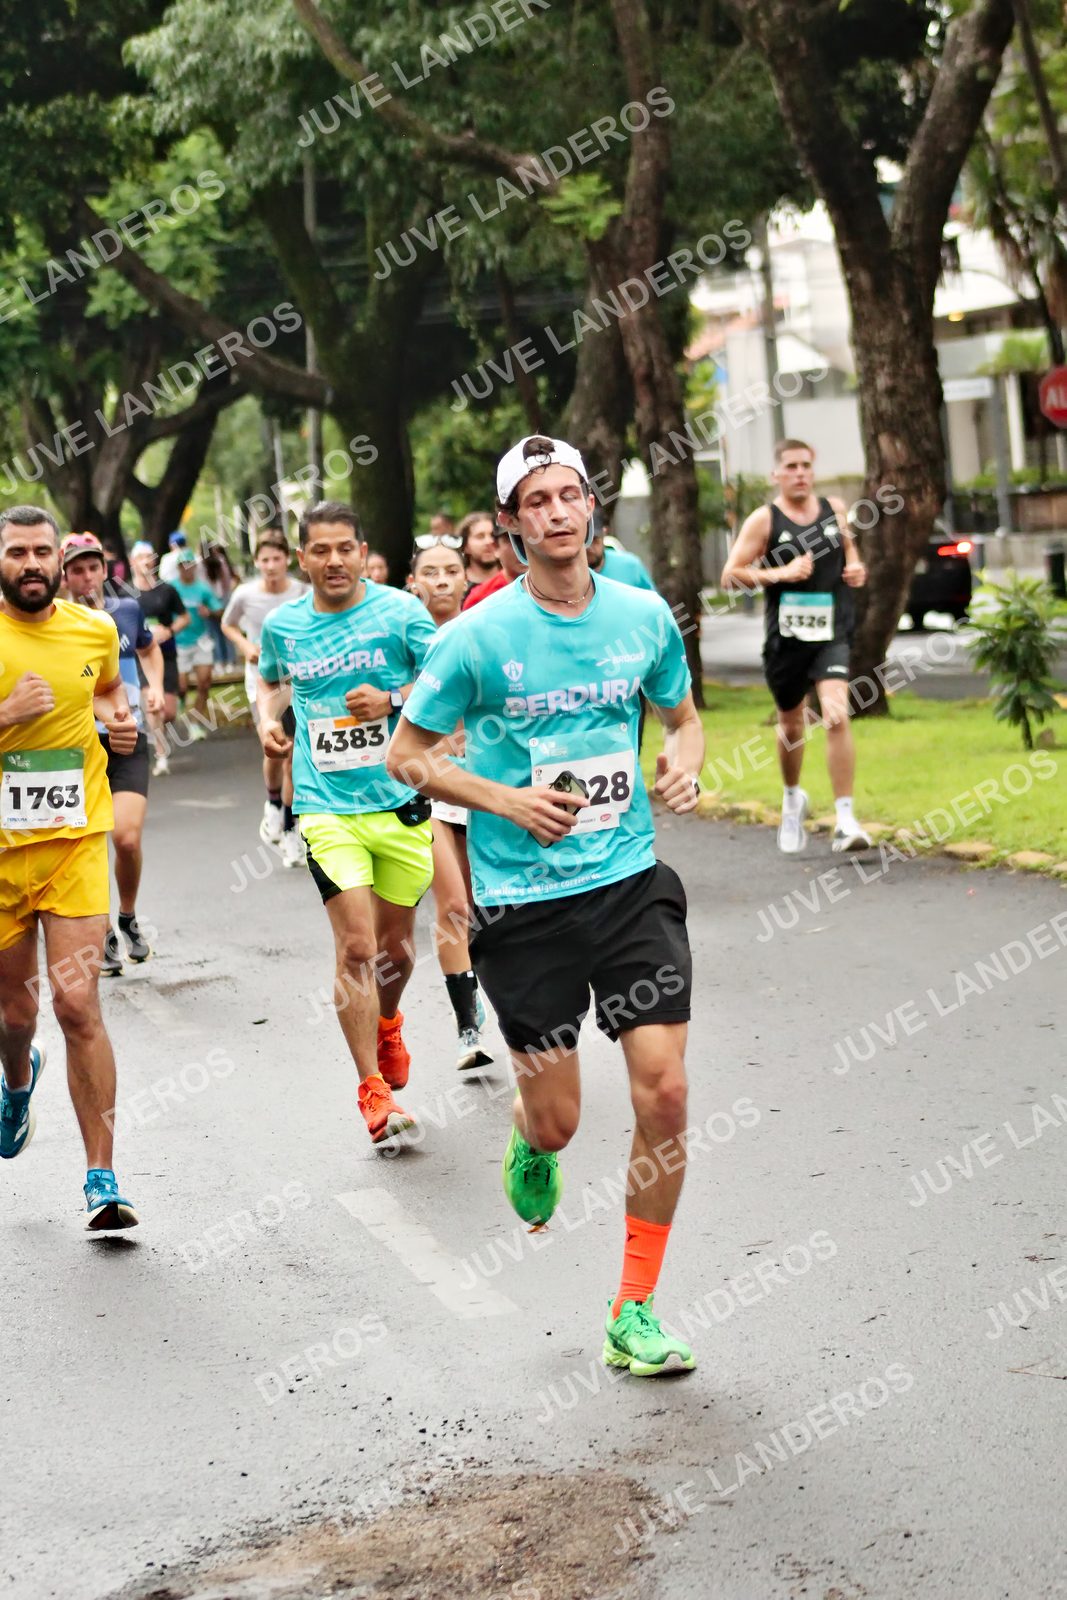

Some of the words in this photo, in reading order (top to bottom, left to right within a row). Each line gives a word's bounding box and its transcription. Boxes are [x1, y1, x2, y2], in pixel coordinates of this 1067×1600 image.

[784, 614, 827, 628] 3326
[287, 648, 387, 680] PERDURA
[316, 723, 385, 754] 4383
[9, 784, 81, 810] 1763
[578, 771, 630, 806] 28
